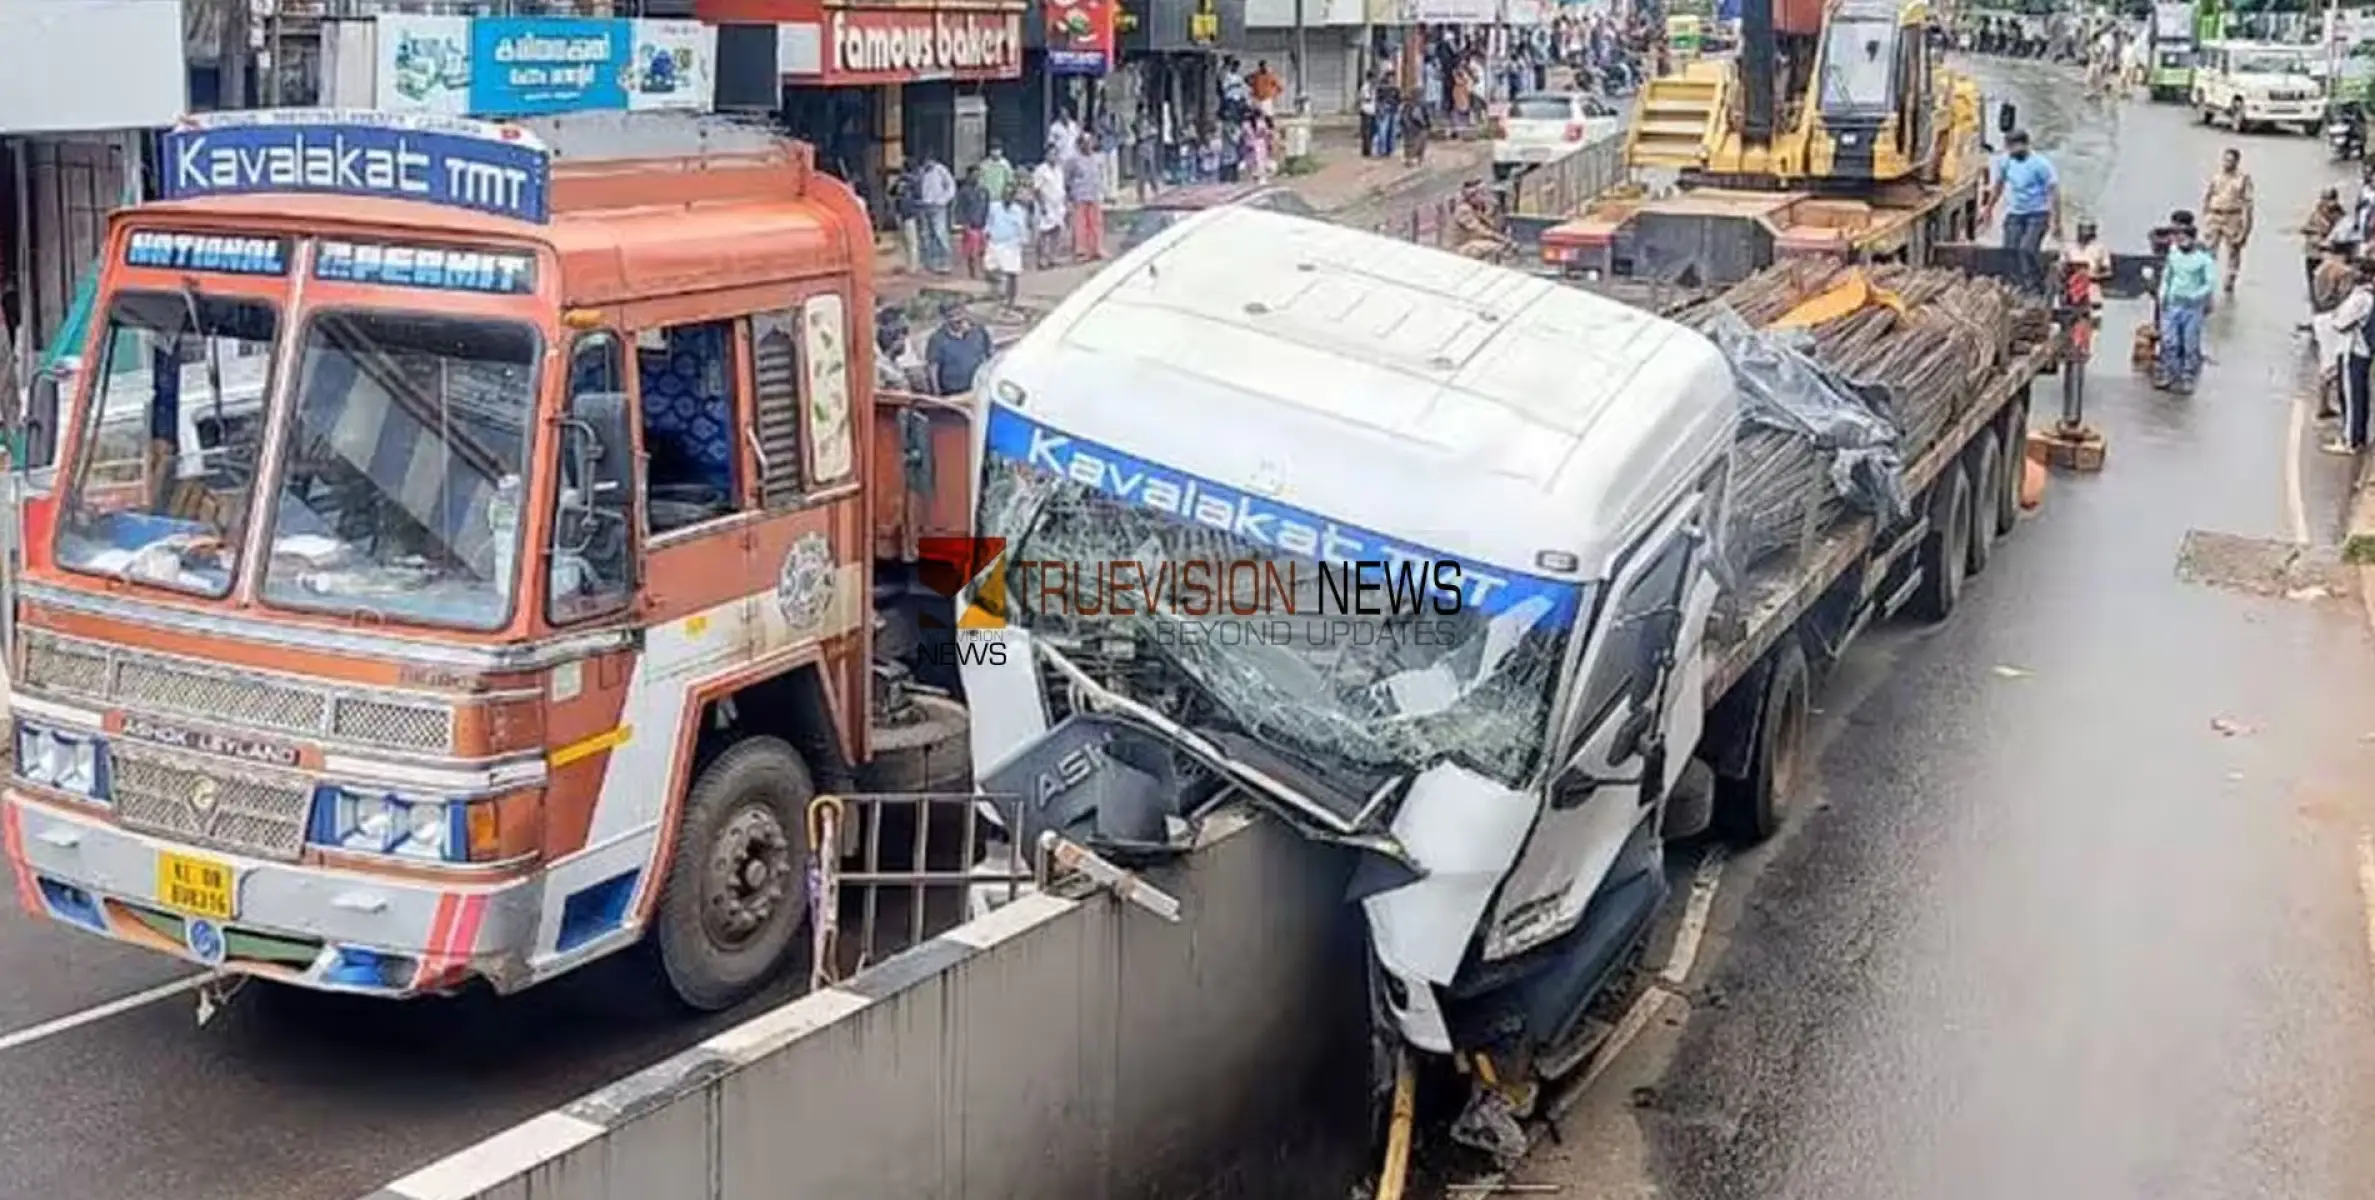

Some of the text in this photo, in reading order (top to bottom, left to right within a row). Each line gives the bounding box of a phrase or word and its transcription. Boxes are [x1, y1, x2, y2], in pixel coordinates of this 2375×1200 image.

[833, 10, 933, 71] famous
[178, 133, 527, 210] Kavalakat TMT
[129, 232, 282, 273] NATIONAL
[1027, 427, 1363, 568] Kavalakat
